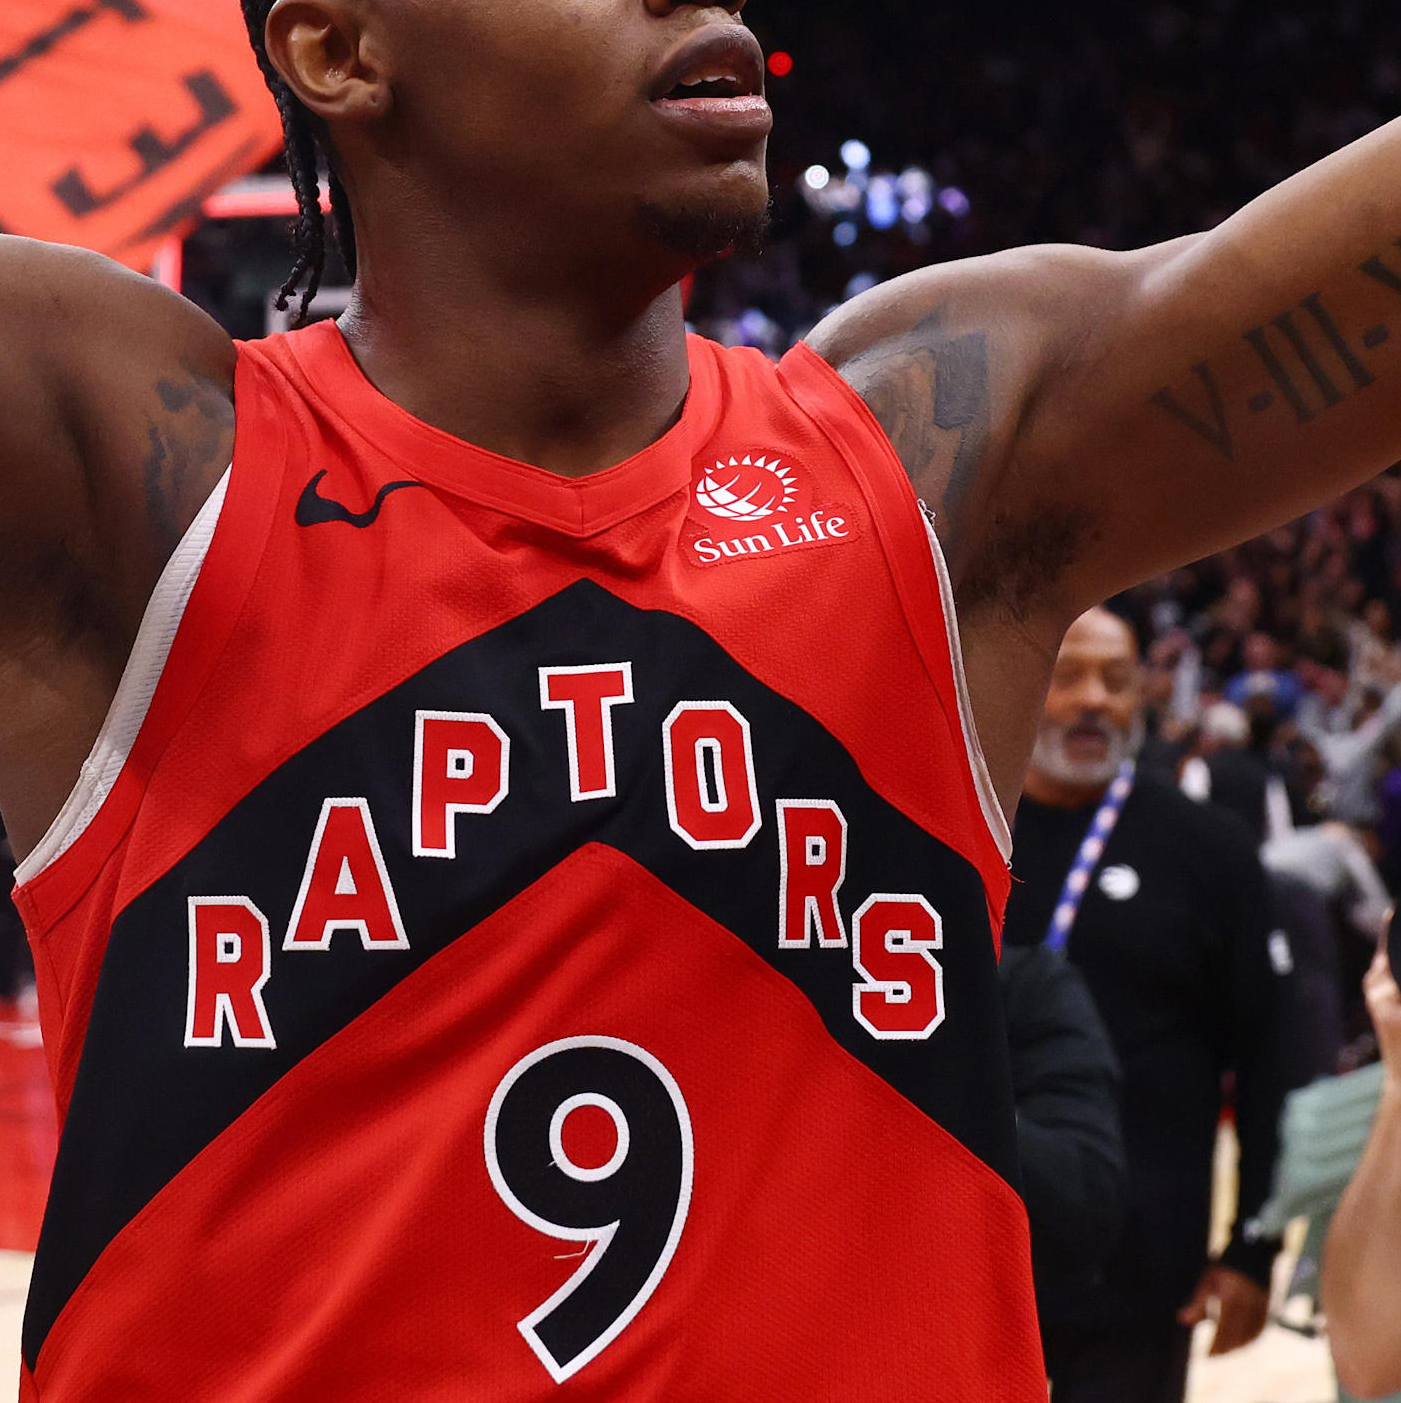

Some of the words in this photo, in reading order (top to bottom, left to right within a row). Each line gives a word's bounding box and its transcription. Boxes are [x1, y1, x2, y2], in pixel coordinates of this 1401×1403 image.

[693, 534, 775, 563] Sun
[769, 510, 849, 547] Life
[184, 661, 946, 1050] RAPTORS
[483, 1034, 695, 1385] 9
